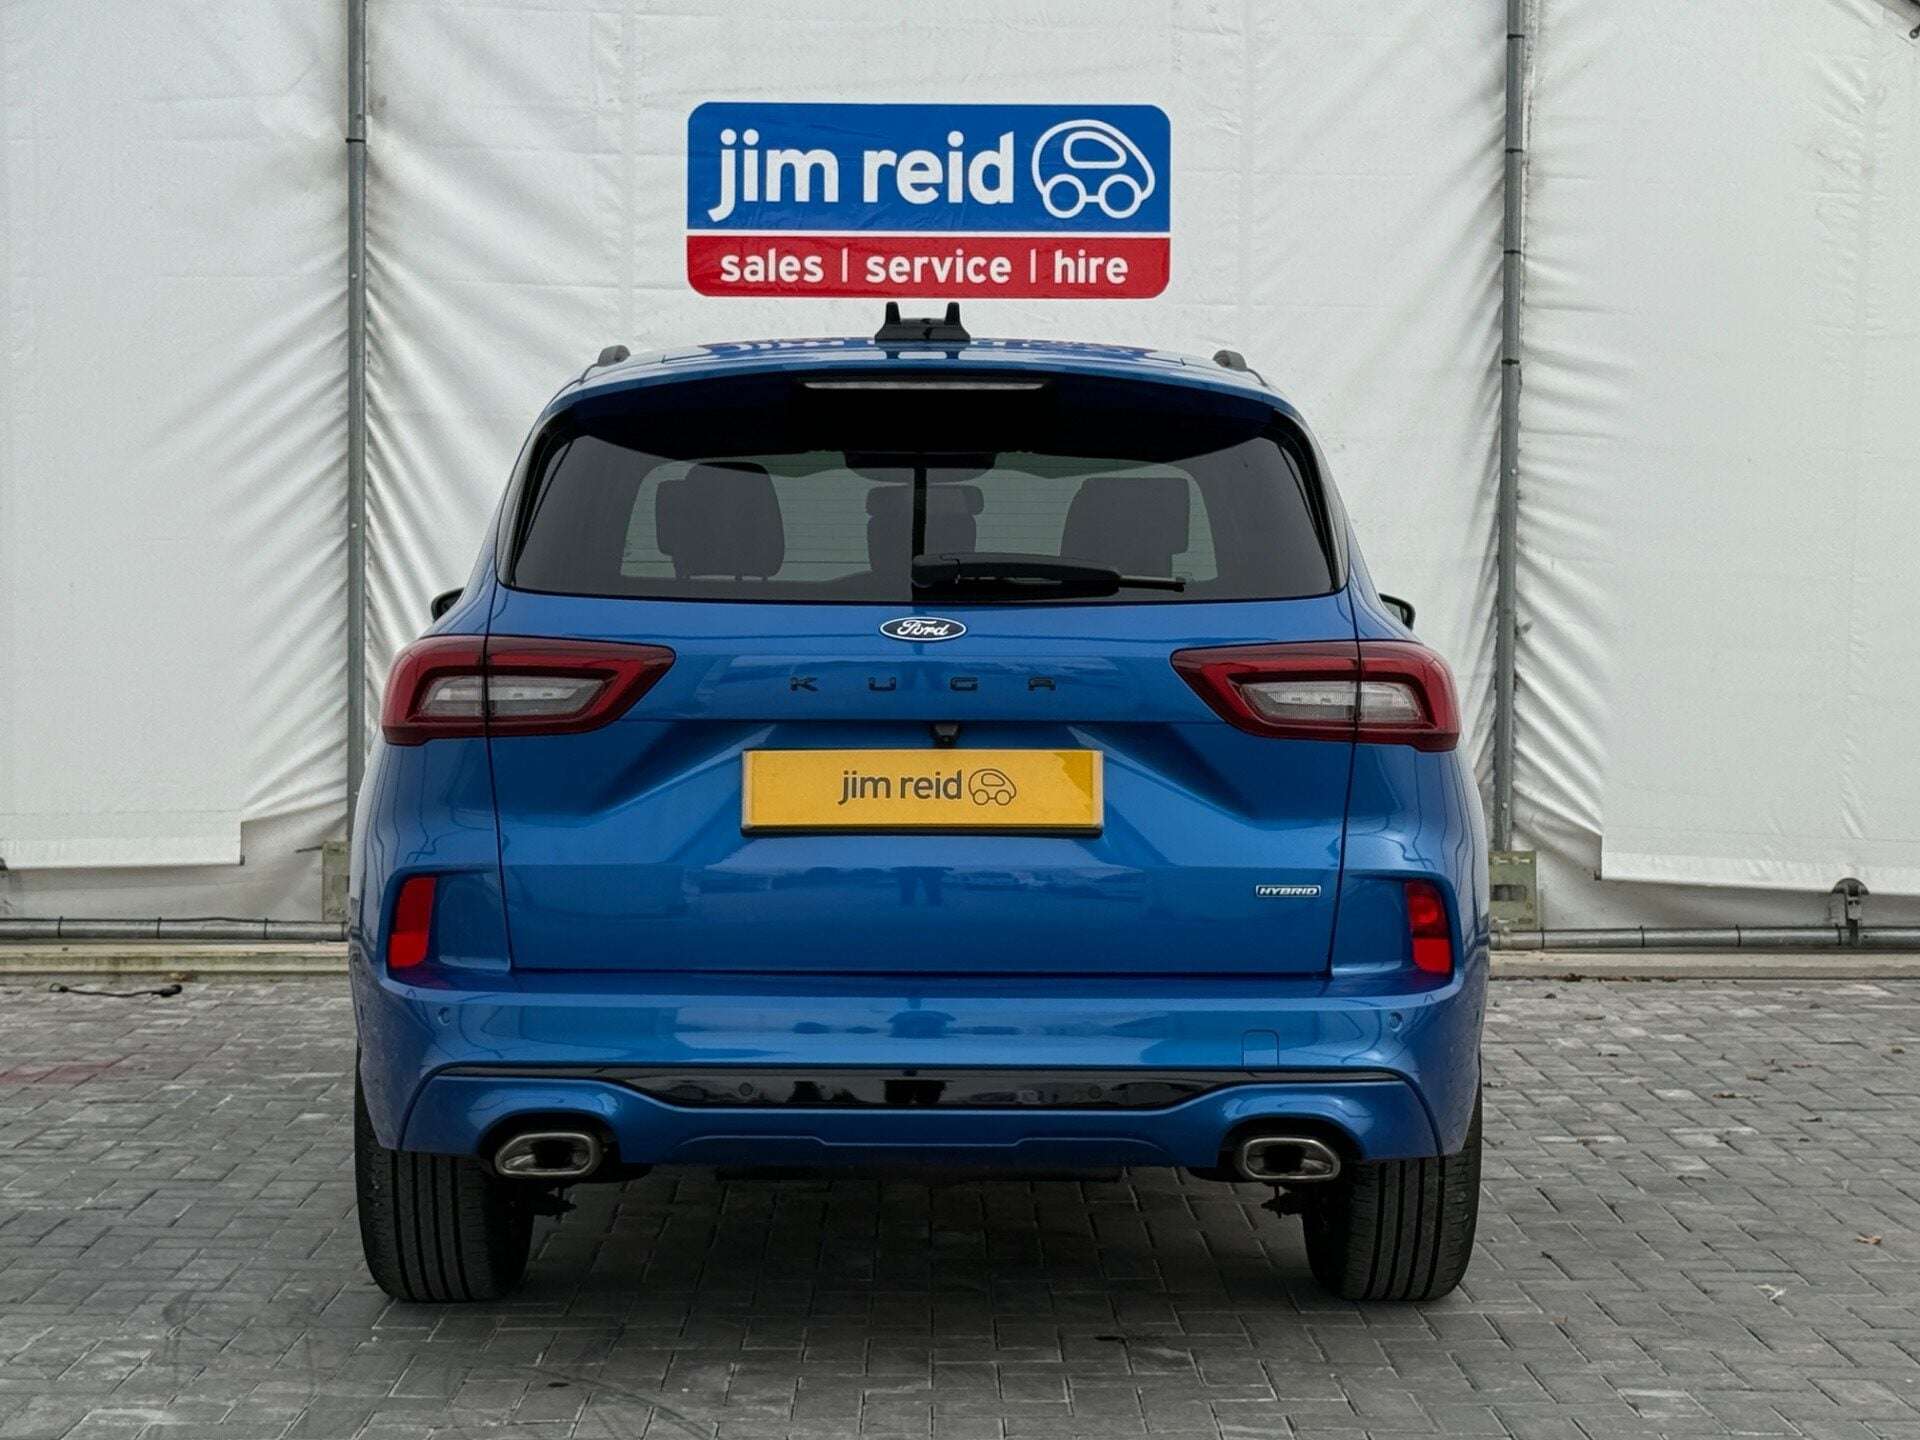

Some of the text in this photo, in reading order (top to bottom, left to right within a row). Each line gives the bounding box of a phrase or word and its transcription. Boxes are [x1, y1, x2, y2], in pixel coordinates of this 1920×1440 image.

[707, 128, 1014, 223] jim reid
[720, 248, 1129, 284] sales service hire
[896, 619, 949, 637] Ford
[791, 677, 1056, 692] KUGA
[838, 771, 962, 806] jim reid
[1259, 887, 1318, 896] HYBRID
